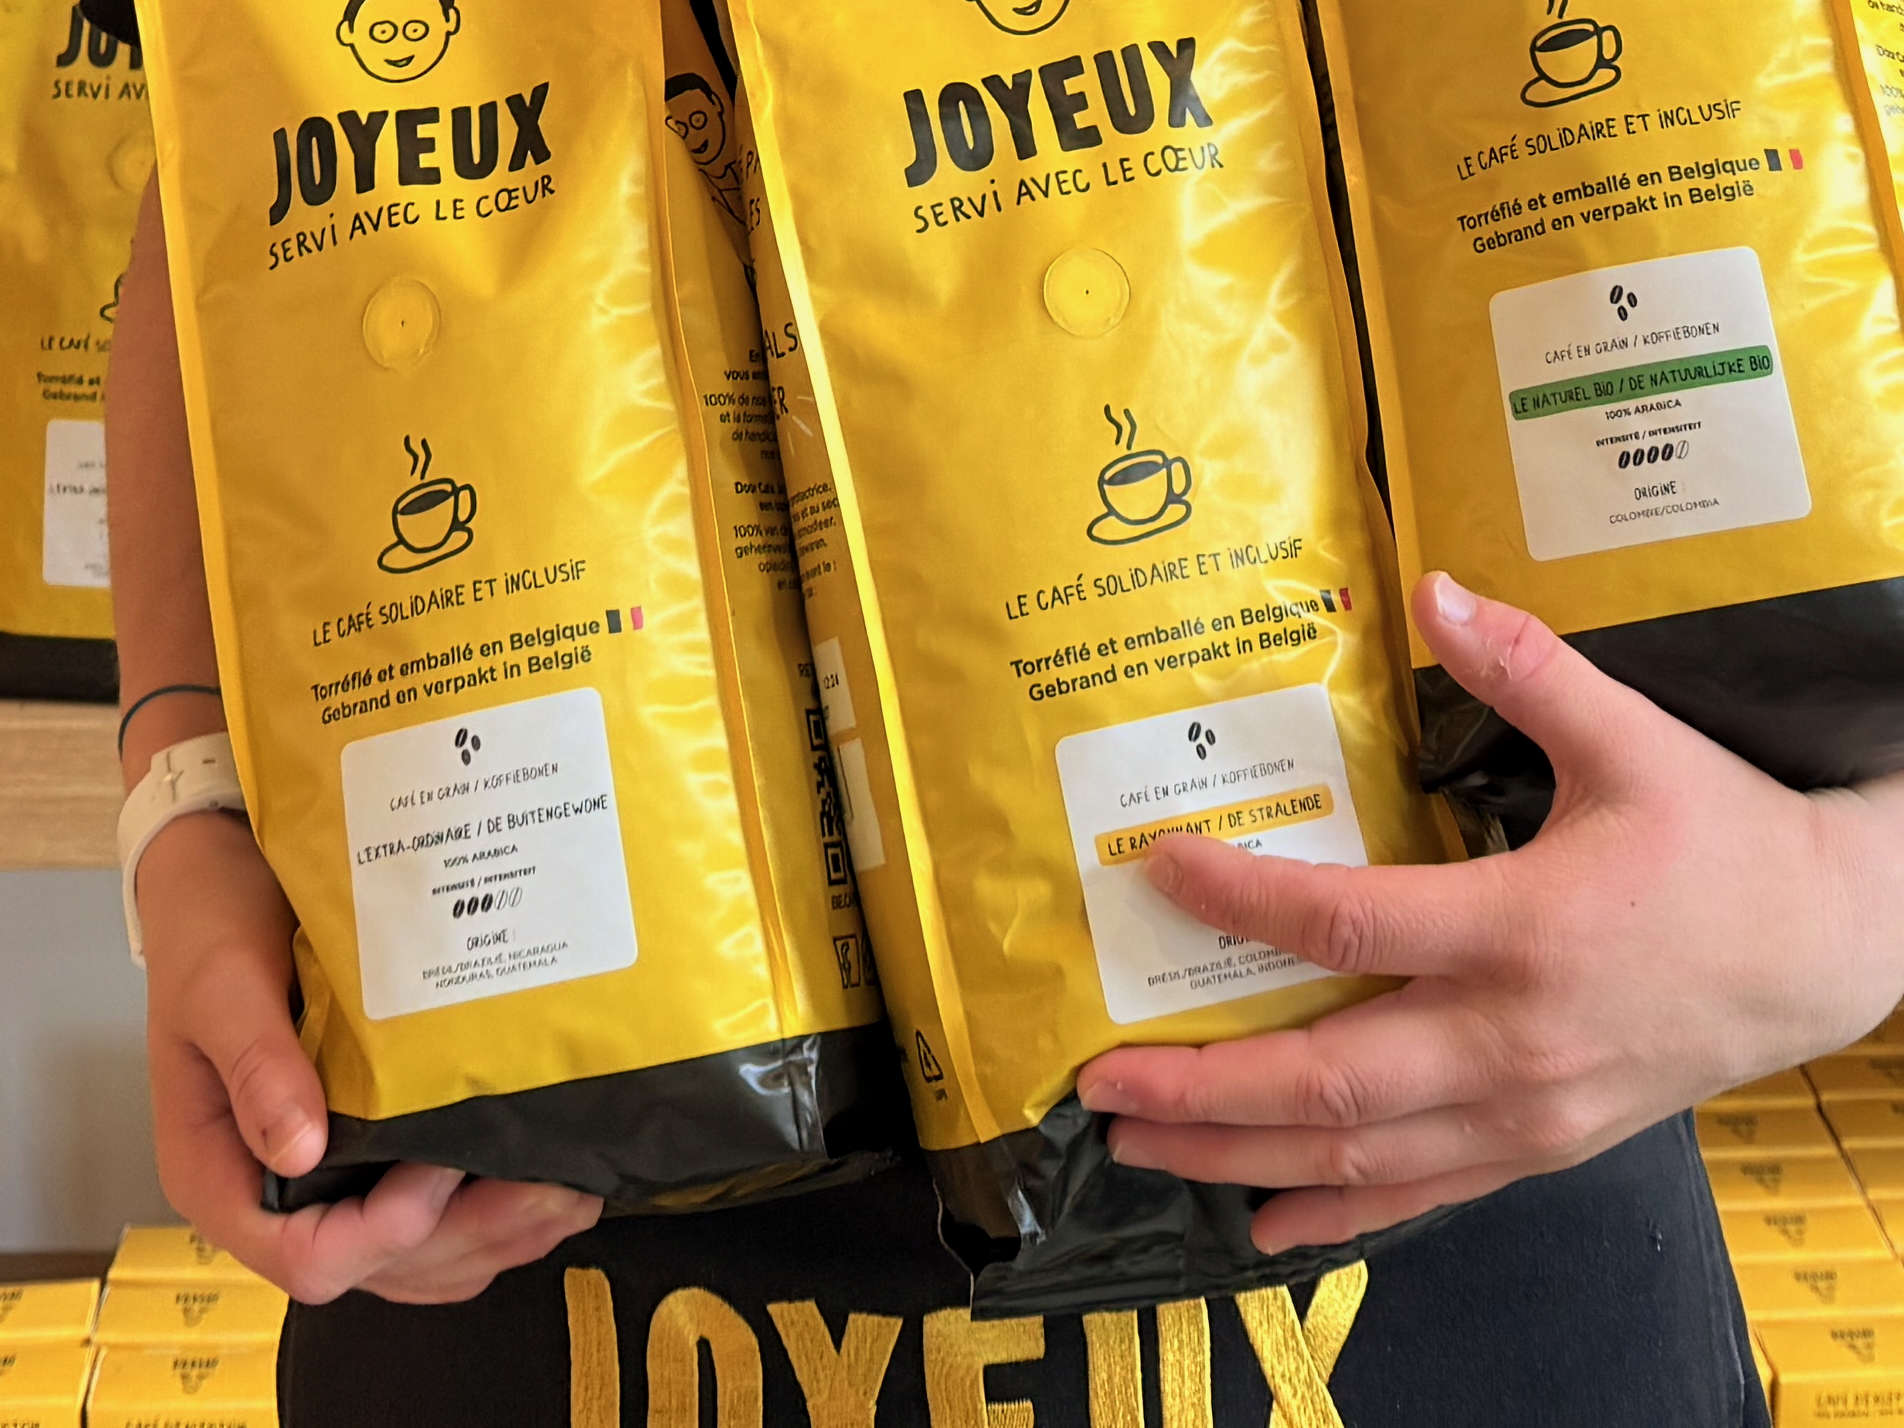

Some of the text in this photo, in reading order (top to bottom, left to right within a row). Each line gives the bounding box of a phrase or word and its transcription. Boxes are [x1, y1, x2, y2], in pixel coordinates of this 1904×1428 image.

[903, 37, 1213, 193] JOYEUX
[1457, 162, 1474, 182] LE
[1477, 137, 1520, 174] CAFÉ
[1624, 114, 1650, 134] ET
[269, 81, 553, 226] JOYEUX
[1016, 169, 1090, 206] AVEC
[1102, 157, 1135, 186] LE
[1143, 143, 1224, 177] CŒUR
[349, 202, 420, 241] AVEC
[435, 198, 464, 221] LE
[476, 174, 555, 218] CŒUR
[1457, 158, 1760, 232] Torréfié et emballé en Belgique
[1473, 180, 1753, 255] Gebrand en verpakt in België
[1545, 343, 1573, 364] CAFÉ
[1577, 344, 1590, 358] EN
[1513, 397, 1529, 415] LE
[1532, 385, 1591, 413] NATUREL
[1629, 374, 1645, 392] DE
[1006, 594, 1029, 620] LE
[1037, 576, 1087, 612] CAFÉ
[1196, 553, 1220, 575] ET
[377, 664, 394, 683] et
[480, 640, 503, 657] en
[510, 621, 600, 651] Belgique
[1010, 600, 1319, 678] Torréfié et emballé en Belgique
[1029, 622, 1317, 701] Gebrand en verpakt in België
[320, 645, 591, 725] Gebrand en verpakt in België
[1108, 838, 1125, 856] LE
[1228, 811, 1244, 828] DE
[1249, 794, 1322, 823] STRALENDE
